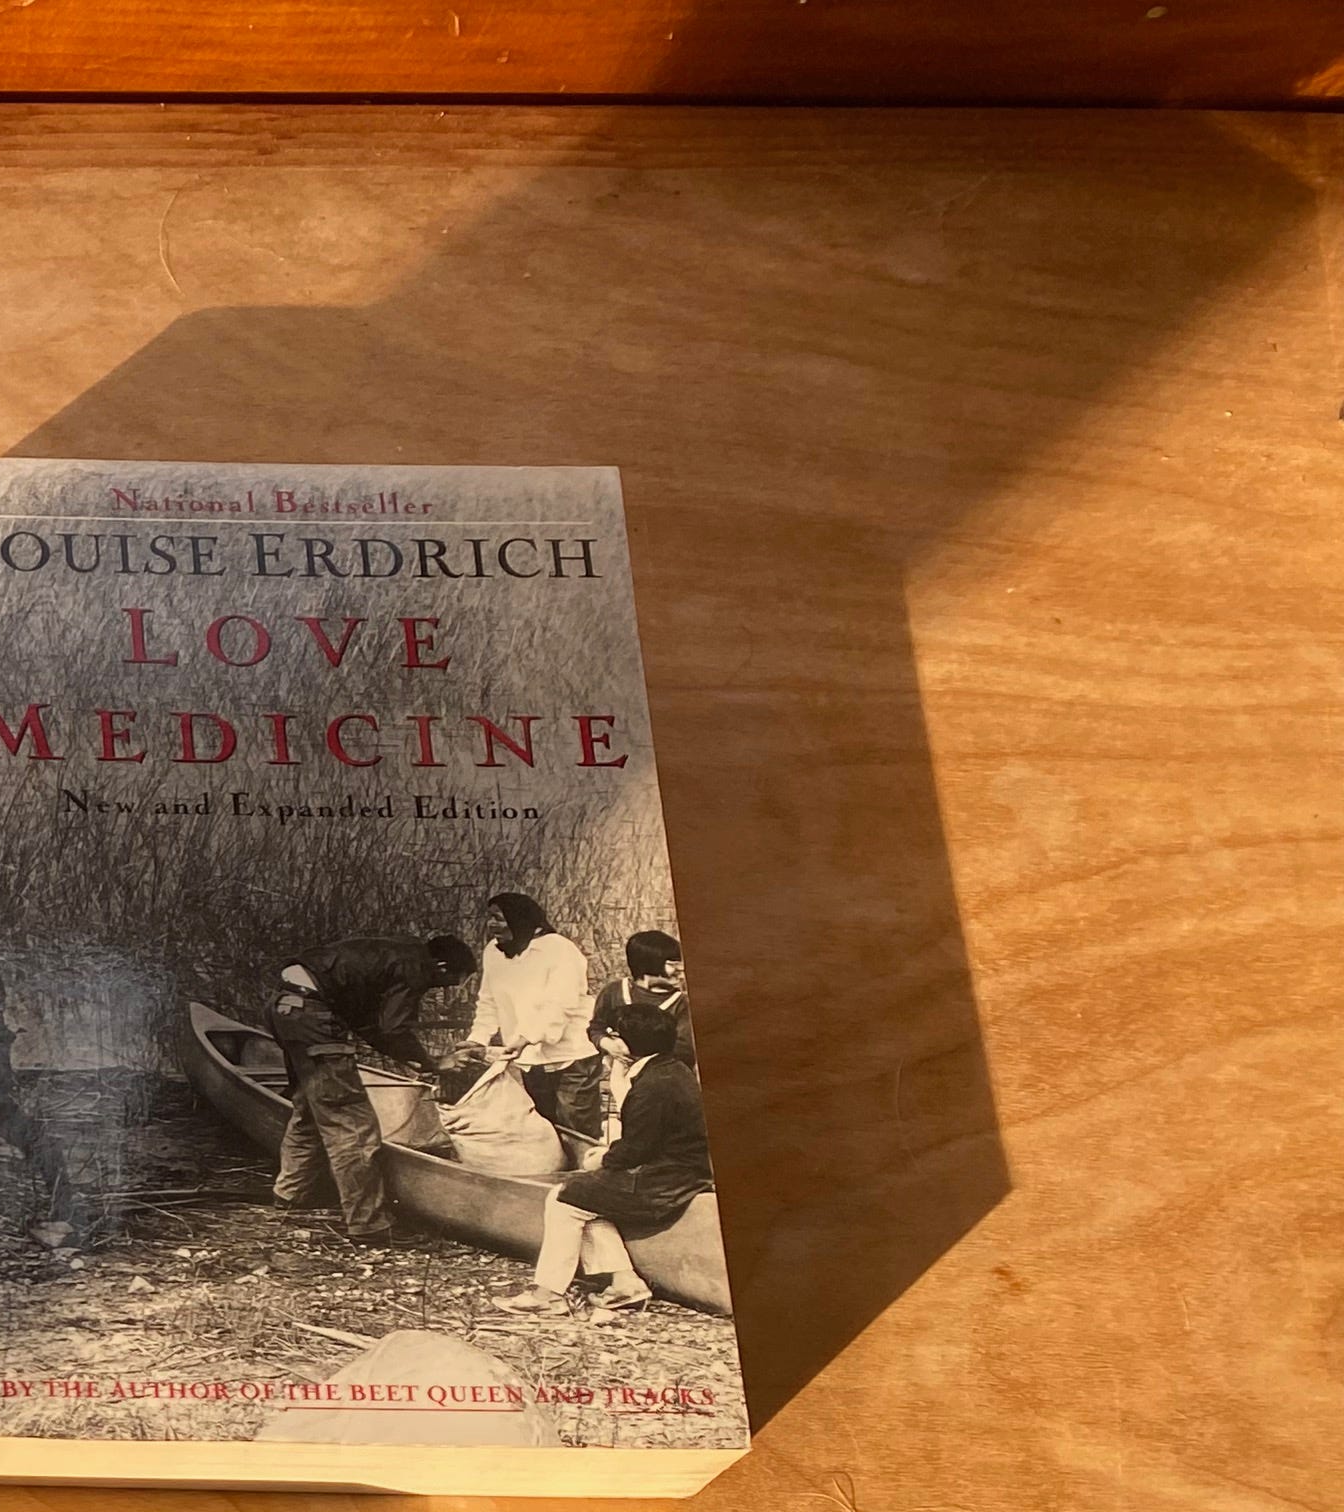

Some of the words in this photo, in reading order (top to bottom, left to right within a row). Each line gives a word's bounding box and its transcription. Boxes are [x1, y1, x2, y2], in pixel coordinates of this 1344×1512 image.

[111, 487, 256, 514] National
[274, 489, 434, 515] Bestseller
[251, 531, 605, 580] ERDRICH
[121, 606, 453, 671] LOVE
[62, 789, 137, 815] New
[154, 793, 210, 816] and
[230, 791, 395, 825] Expanded
[413, 795, 541, 821] Edition
[1, 1379, 34, 1398] BY
[44, 1380, 101, 1399] THE
[111, 1381, 232, 1400] AUTHOR
[240, 1382, 275, 1401] OF
[286, 1383, 342, 1401] THE
[351, 1385, 419, 1402] BEET
[427, 1385, 524, 1407] QUEEN
[535, 1386, 594, 1406] AND
[605, 1386, 716, 1407] TRACKS
